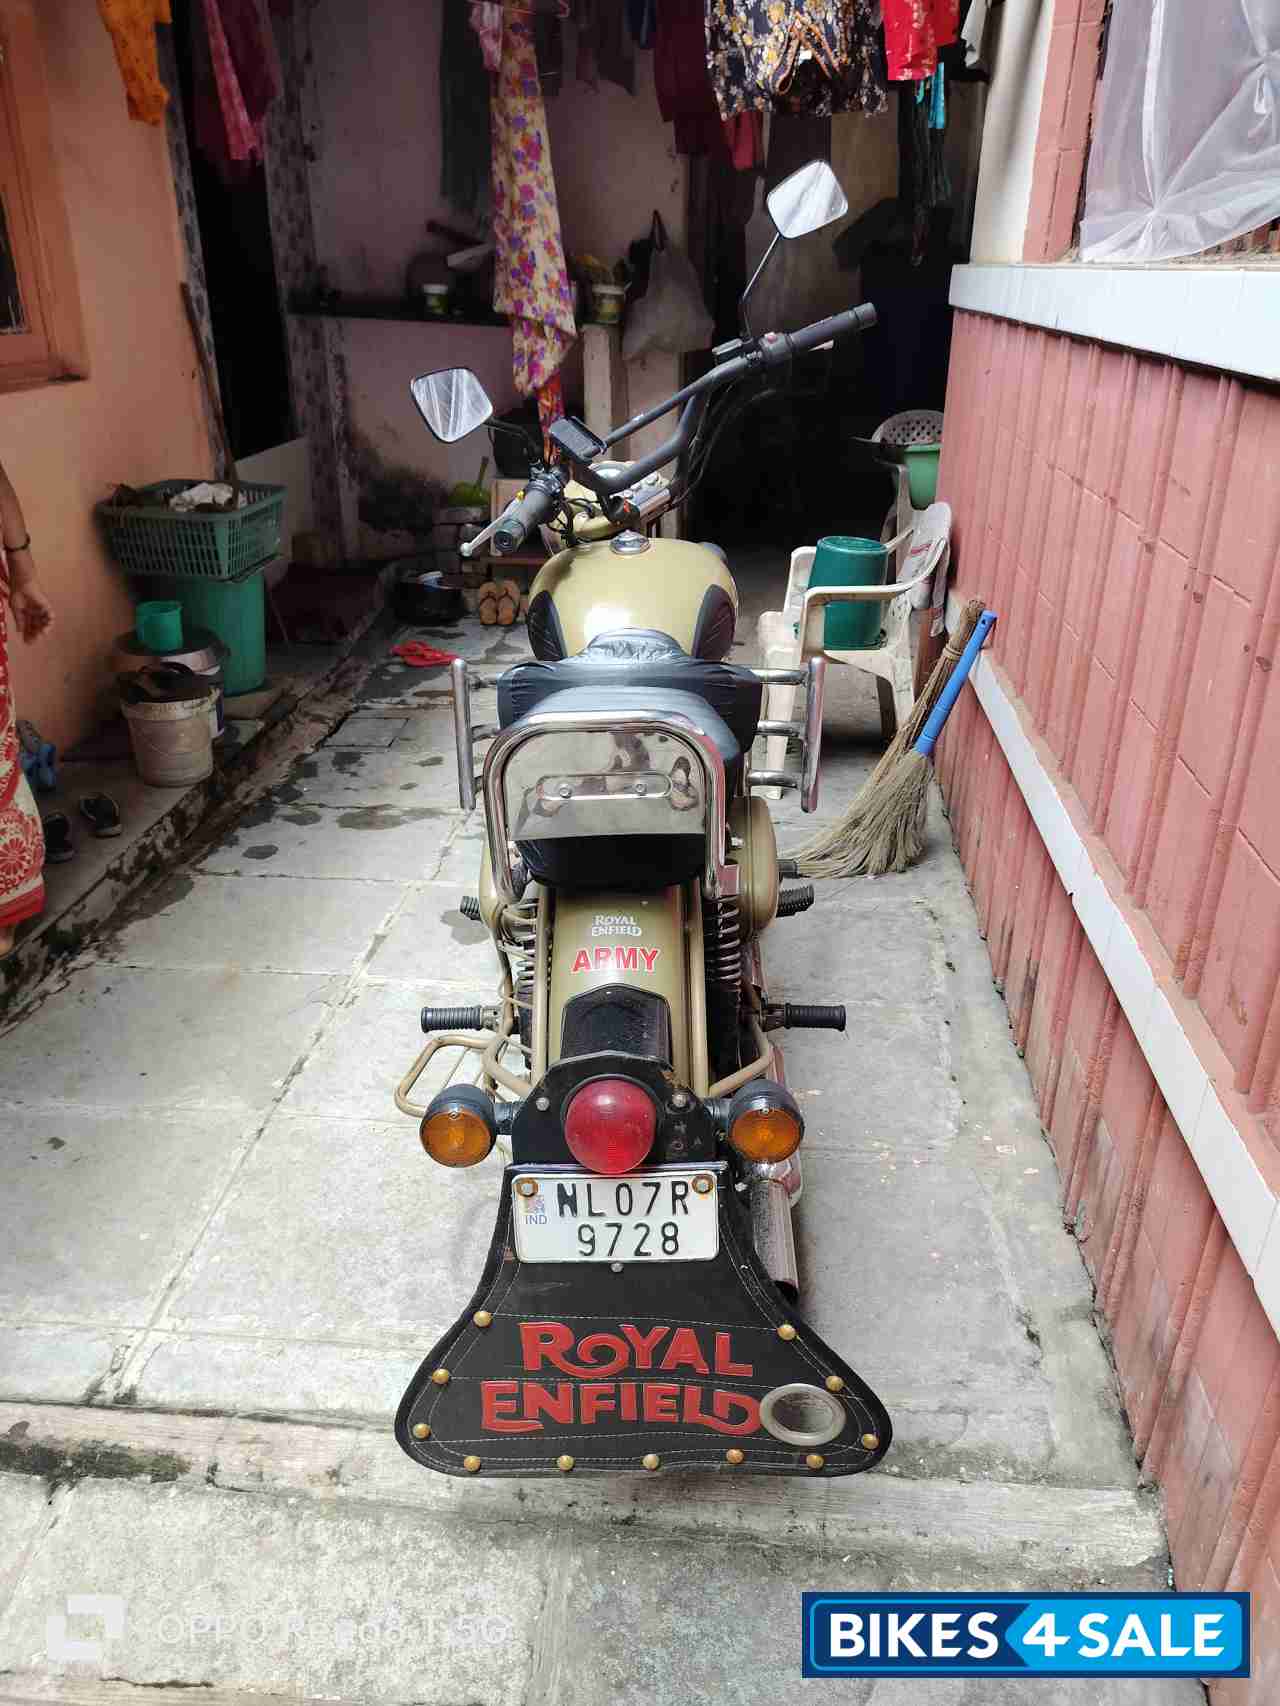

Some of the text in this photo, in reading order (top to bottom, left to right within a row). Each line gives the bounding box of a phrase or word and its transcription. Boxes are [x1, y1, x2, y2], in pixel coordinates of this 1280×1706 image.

[591, 926, 642, 937] ENFIELD
[595, 914, 638, 926] ROYAL
[570, 945, 661, 973] ARMY
[556, 1180, 690, 1218] NL07R
[525, 1214, 548, 1226] IND
[577, 1221, 679, 1257] 9728
[517, 1321, 753, 1379] ROYAL
[480, 1380, 764, 1436] ENFIELD
